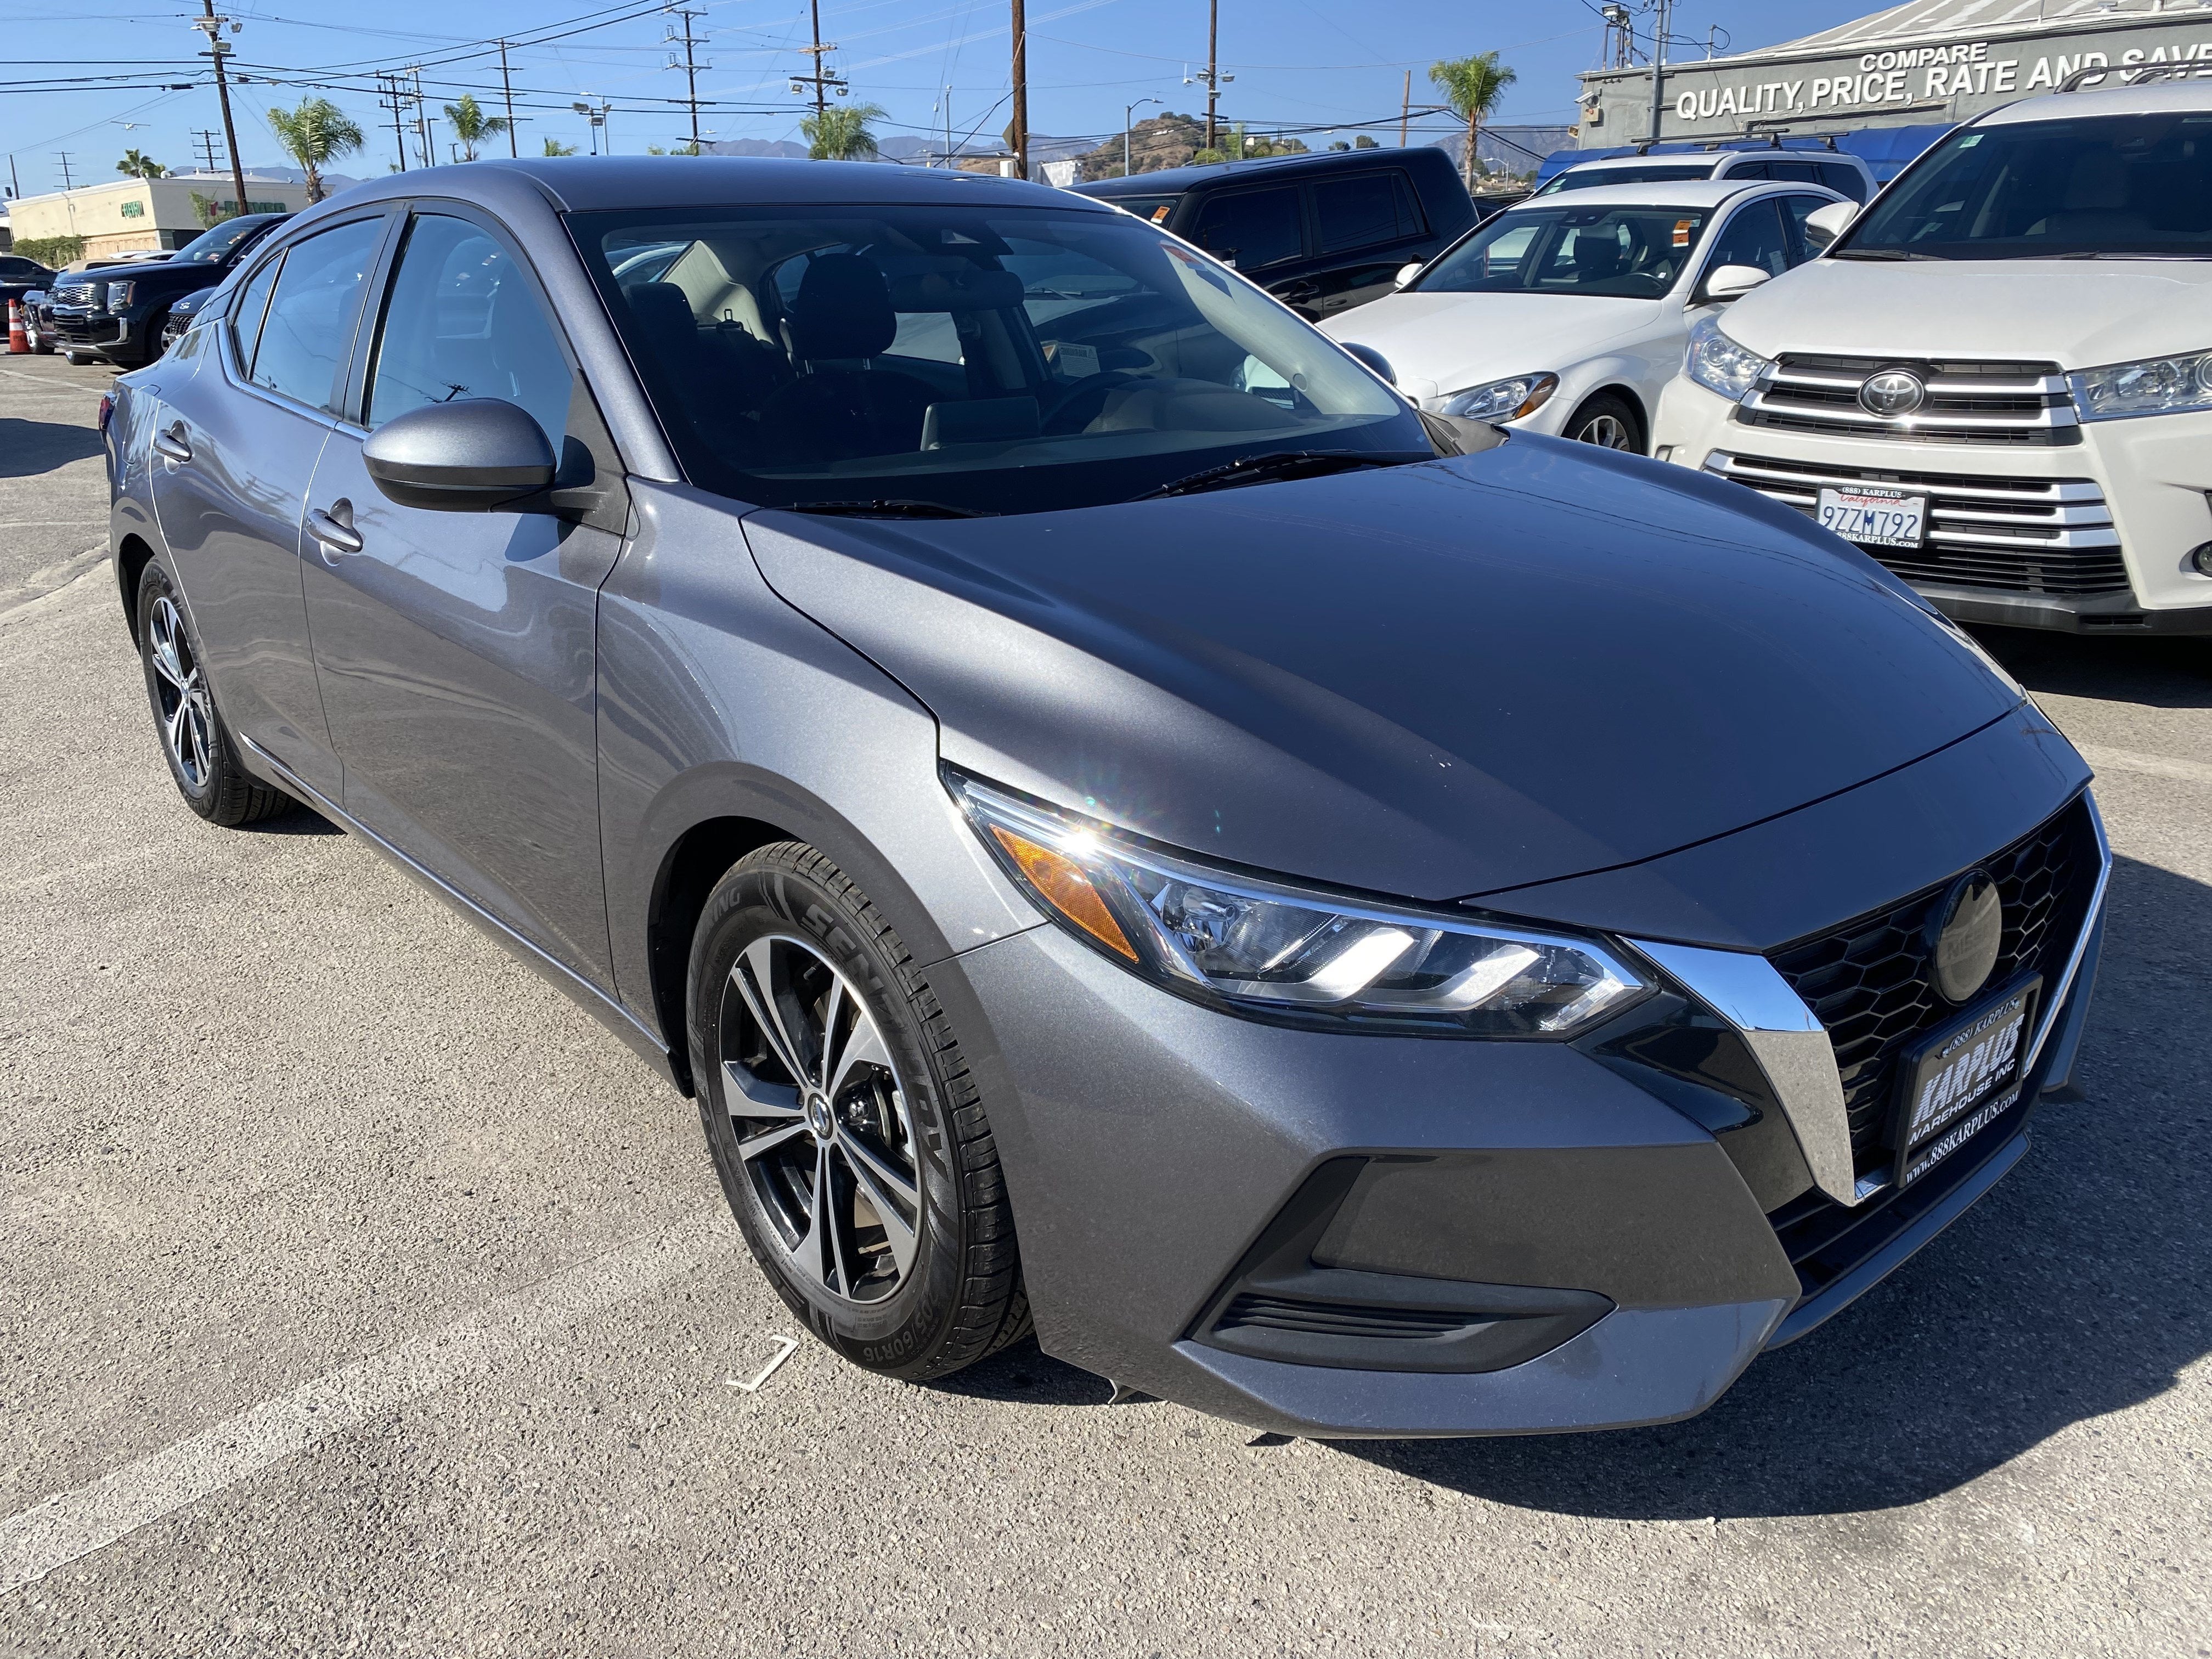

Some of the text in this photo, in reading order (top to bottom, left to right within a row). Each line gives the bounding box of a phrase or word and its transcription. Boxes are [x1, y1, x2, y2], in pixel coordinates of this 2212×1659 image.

[1860, 42, 1989, 73] COMPARE
[1677, 80, 1805, 121] QUALITY,
[1812, 71, 1914, 108] PRICE,
[1925, 59, 2018, 97] RATE
[2027, 52, 2109, 90] AND
[1842, 486, 1903, 498] (888) KARPLUS
[1824, 505, 1918, 539] 9ZZM792
[1949, 997, 2017, 1052] (888) KARPLUS
[1911, 1013, 2025, 1129] KARPLUS
[1909, 1058, 2016, 1146] WAREHOUSE INC
